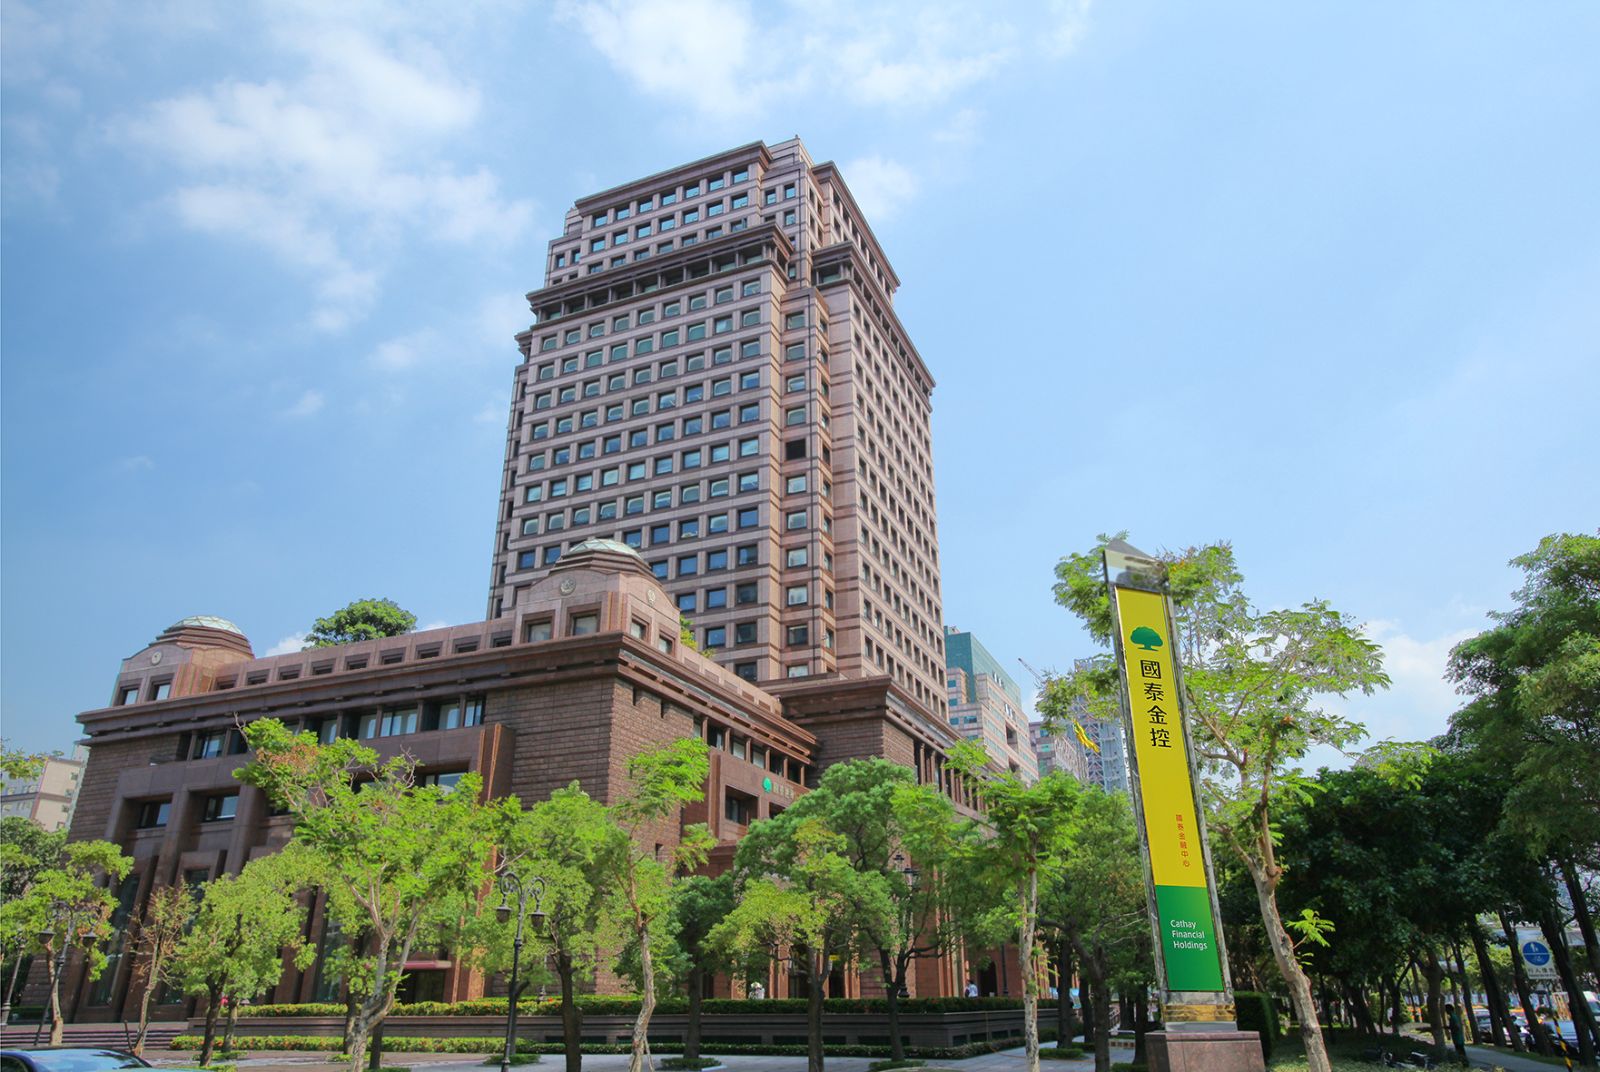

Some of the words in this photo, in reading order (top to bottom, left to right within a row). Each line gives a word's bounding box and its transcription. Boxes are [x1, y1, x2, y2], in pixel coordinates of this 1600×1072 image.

[1140, 660, 1172, 748] 國泰金控
[1170, 919, 1197, 930] Cathay
[1171, 930, 1205, 939] Financial
[1173, 940, 1208, 951] Holdings
